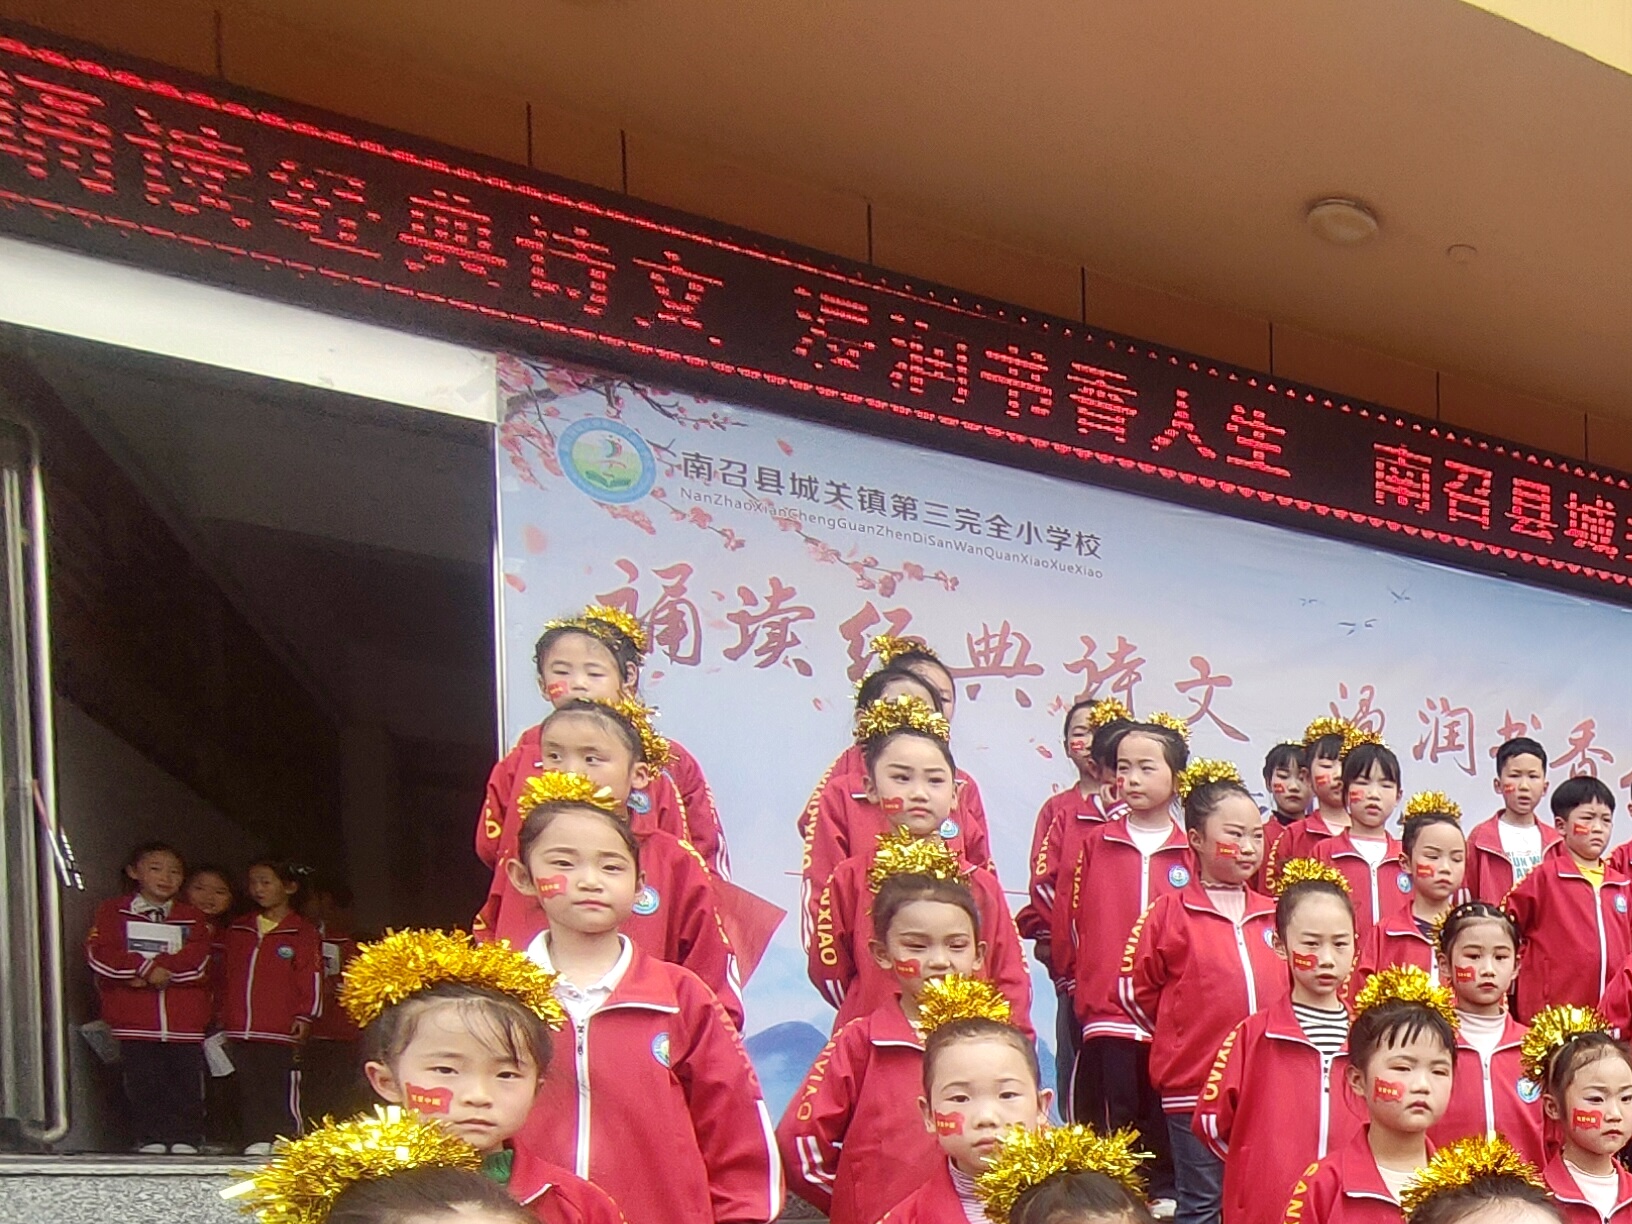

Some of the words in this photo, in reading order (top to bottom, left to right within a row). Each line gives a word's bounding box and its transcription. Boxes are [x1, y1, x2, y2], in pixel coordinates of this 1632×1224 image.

[793, 284, 1291, 479] 浸润书香人生
[682, 450, 1103, 560] 南召县城关镇第三完全小学校
